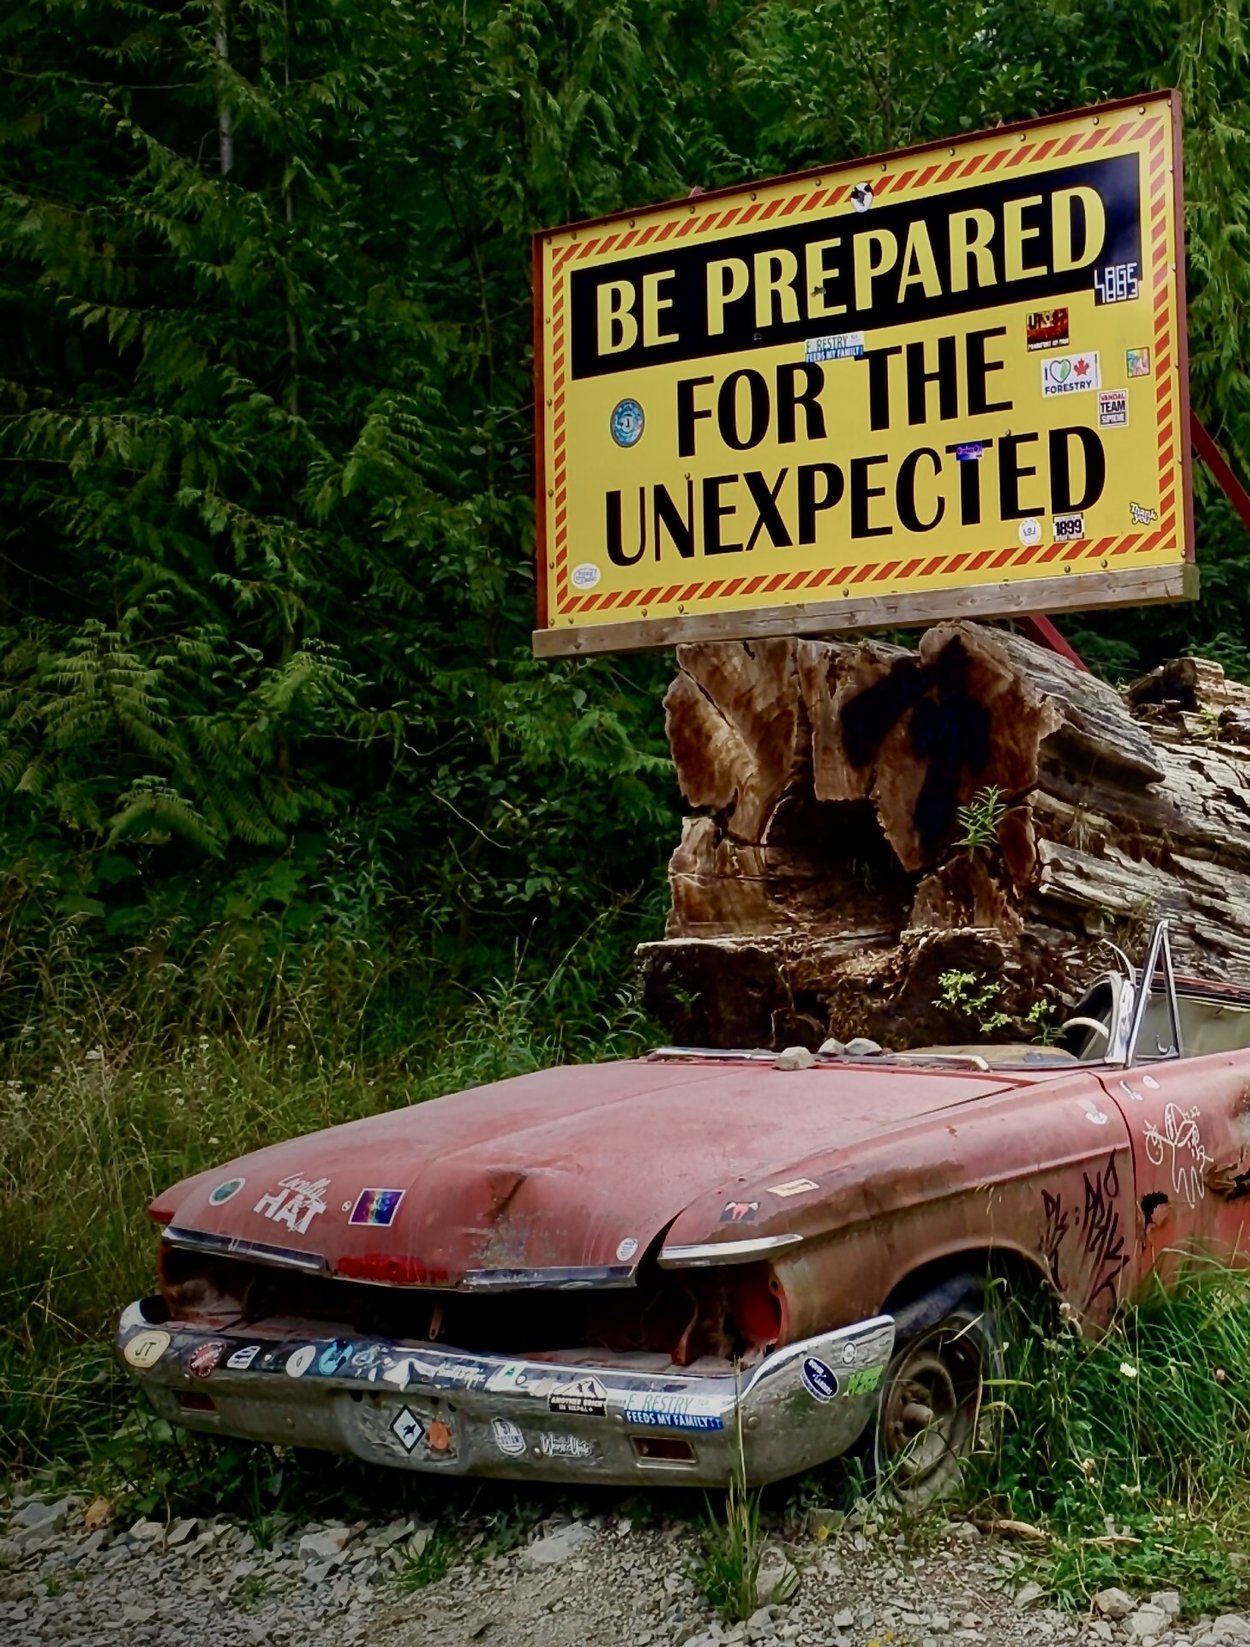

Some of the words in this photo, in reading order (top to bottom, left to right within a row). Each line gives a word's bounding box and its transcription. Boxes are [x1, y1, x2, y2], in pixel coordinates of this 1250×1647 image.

[597, 269, 679, 356] BE
[706, 185, 1107, 336] PREPARED
[677, 361, 828, 457] FOR
[863, 325, 1013, 432] THE
[1045, 380, 1092, 395] FORESTRY
[1100, 400, 1126, 413] TEAM
[605, 425, 1106, 567] UNEXPECTED
[1055, 519, 1082, 536] 1899
[626, 1411, 656, 1424] FEEDS
[657, 1413, 672, 1426] MY
